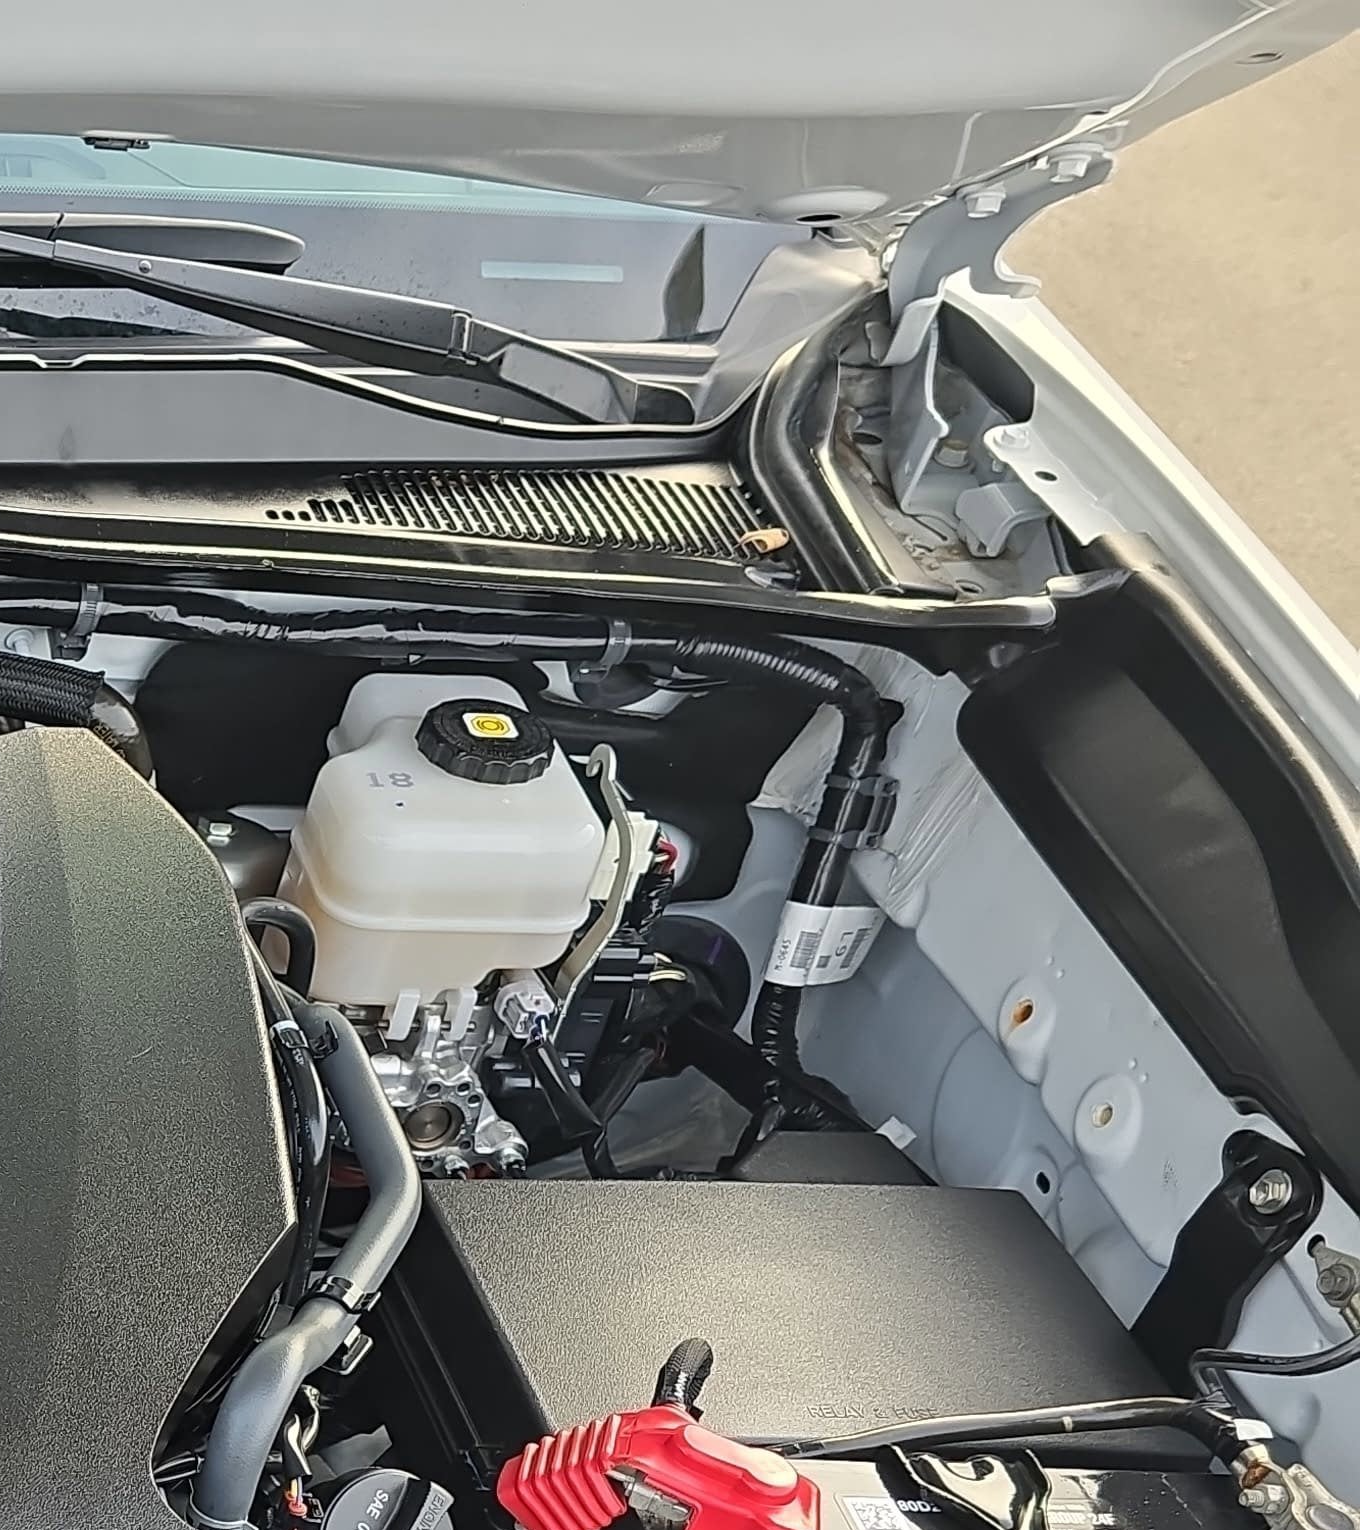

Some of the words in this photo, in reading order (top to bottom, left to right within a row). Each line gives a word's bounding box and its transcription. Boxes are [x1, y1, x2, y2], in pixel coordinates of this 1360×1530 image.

[366, 772, 414, 788] 18
[806, 1405, 865, 1419] RELAY
[893, 1408, 941, 1420] FUSE
[366, 1489, 389, 1520] SAE
